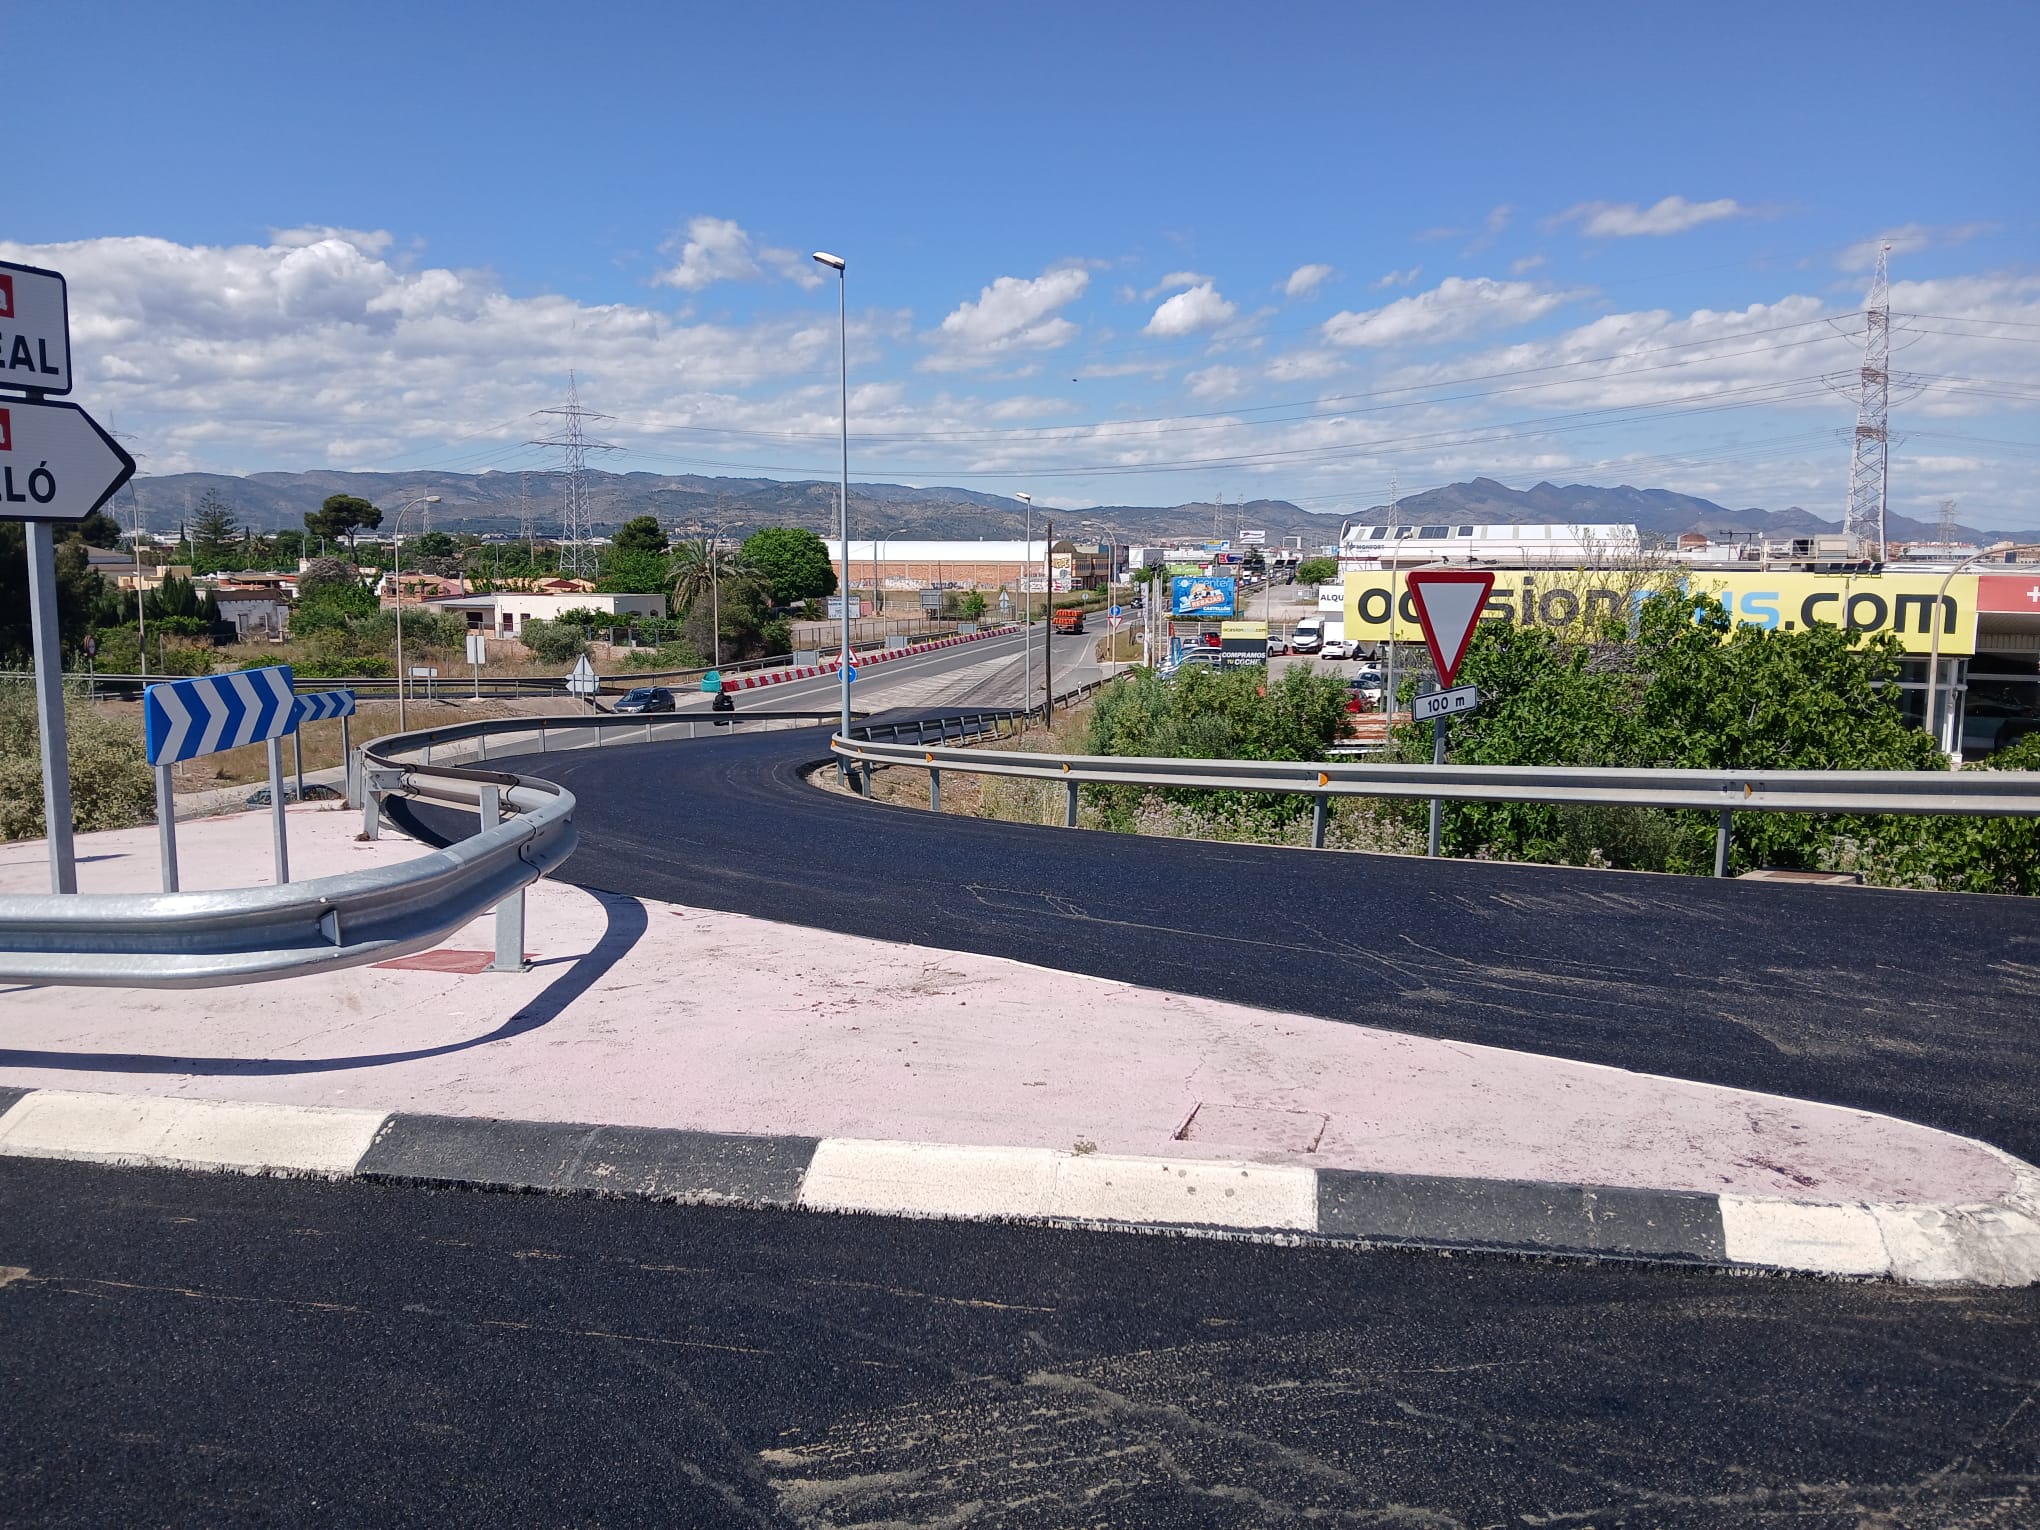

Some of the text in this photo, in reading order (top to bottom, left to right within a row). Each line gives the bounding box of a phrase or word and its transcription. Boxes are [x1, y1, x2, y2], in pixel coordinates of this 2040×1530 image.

[0, 461, 56, 504] LÓ
[1427, 696, 1465, 713] 100 m
